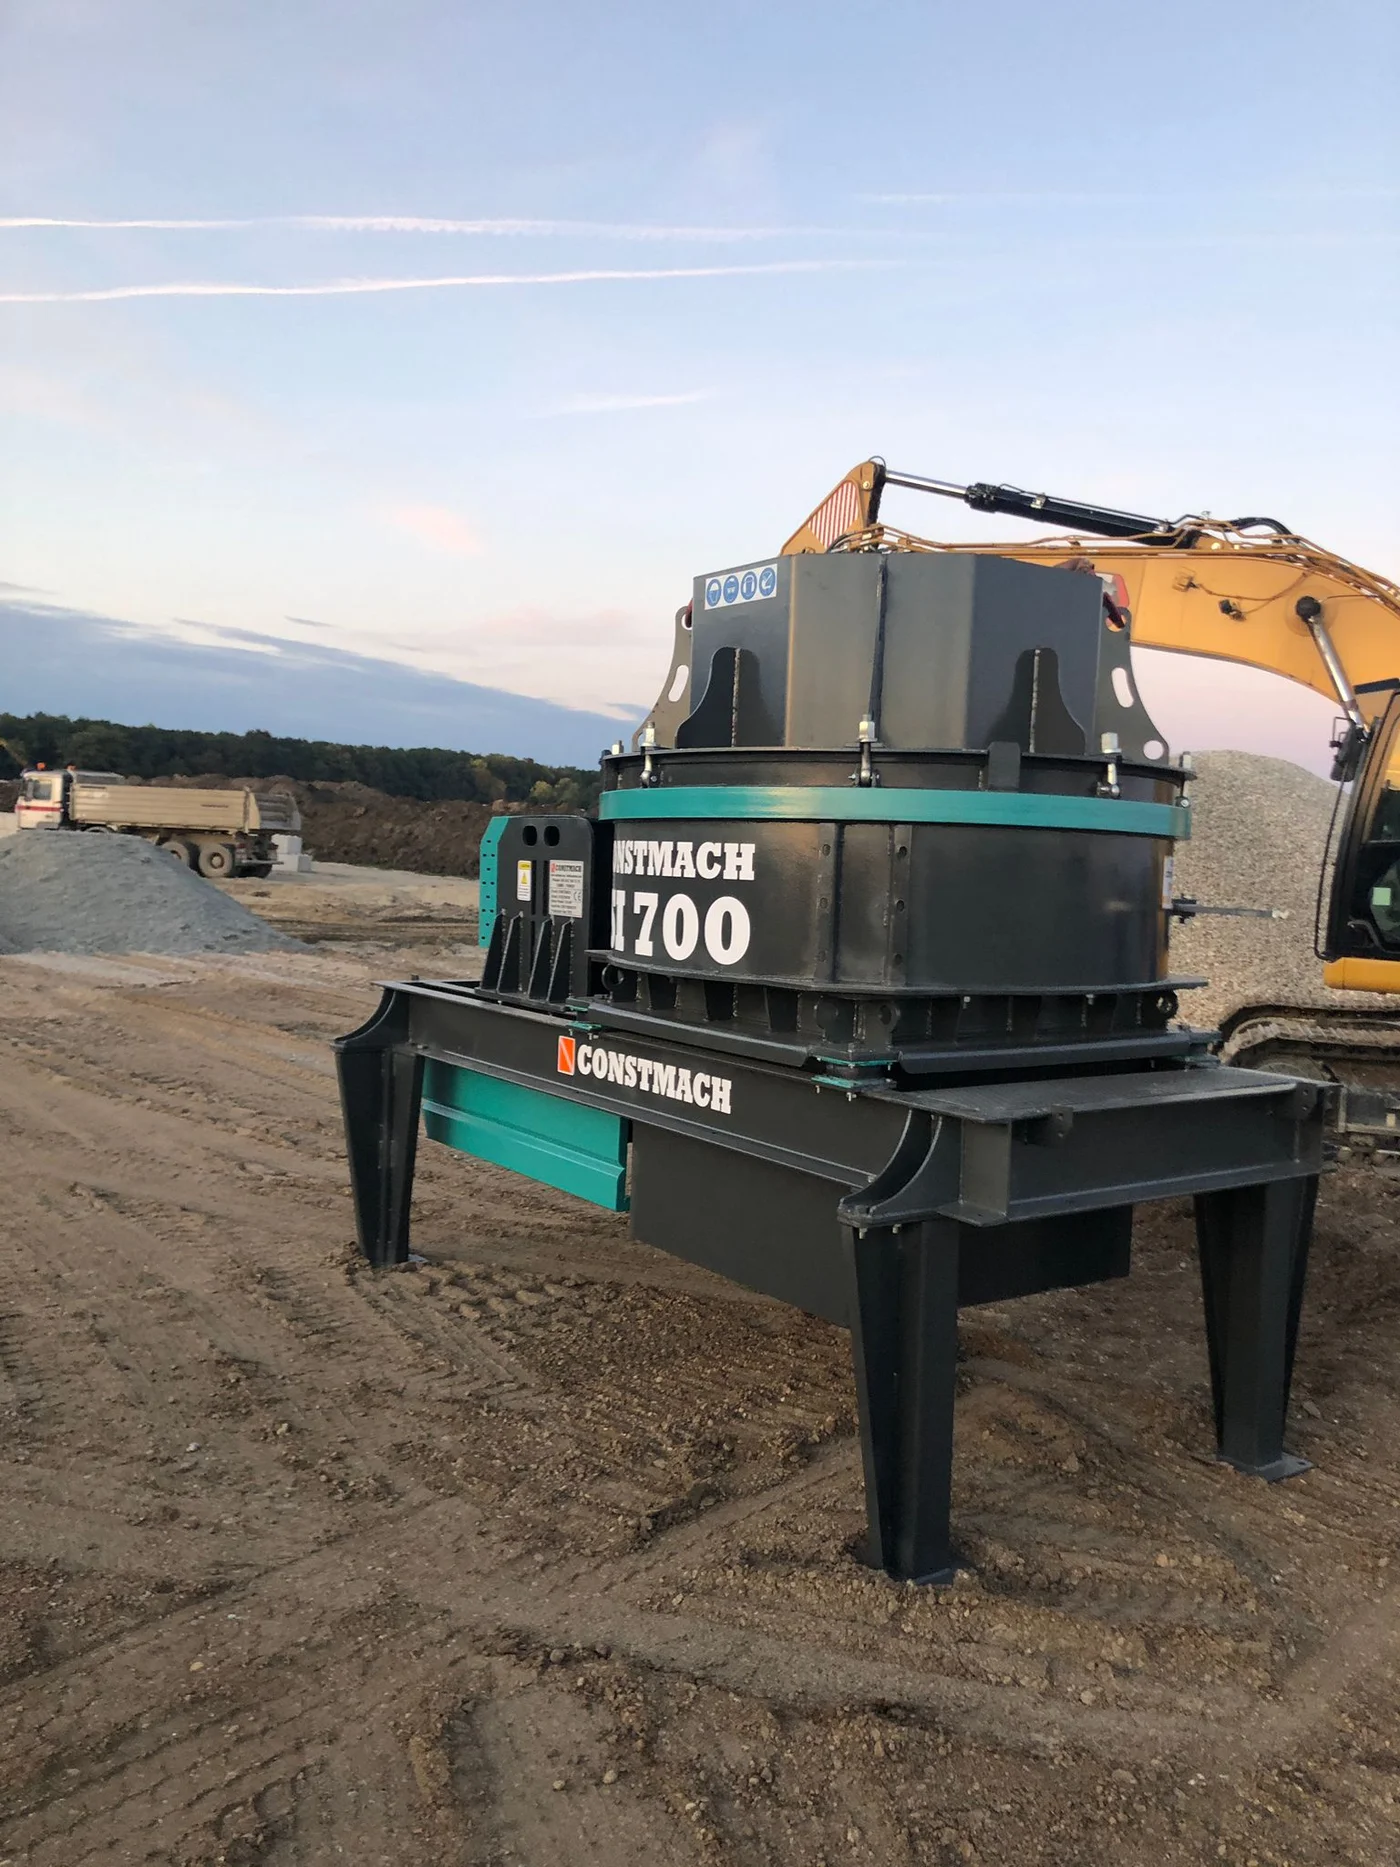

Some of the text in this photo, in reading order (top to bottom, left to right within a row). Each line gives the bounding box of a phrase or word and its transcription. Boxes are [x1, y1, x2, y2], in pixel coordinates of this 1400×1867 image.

[613, 840, 756, 881] NSTMACH
[634, 892, 751, 965] 700
[577, 1044, 732, 1114] CONSTMACH
